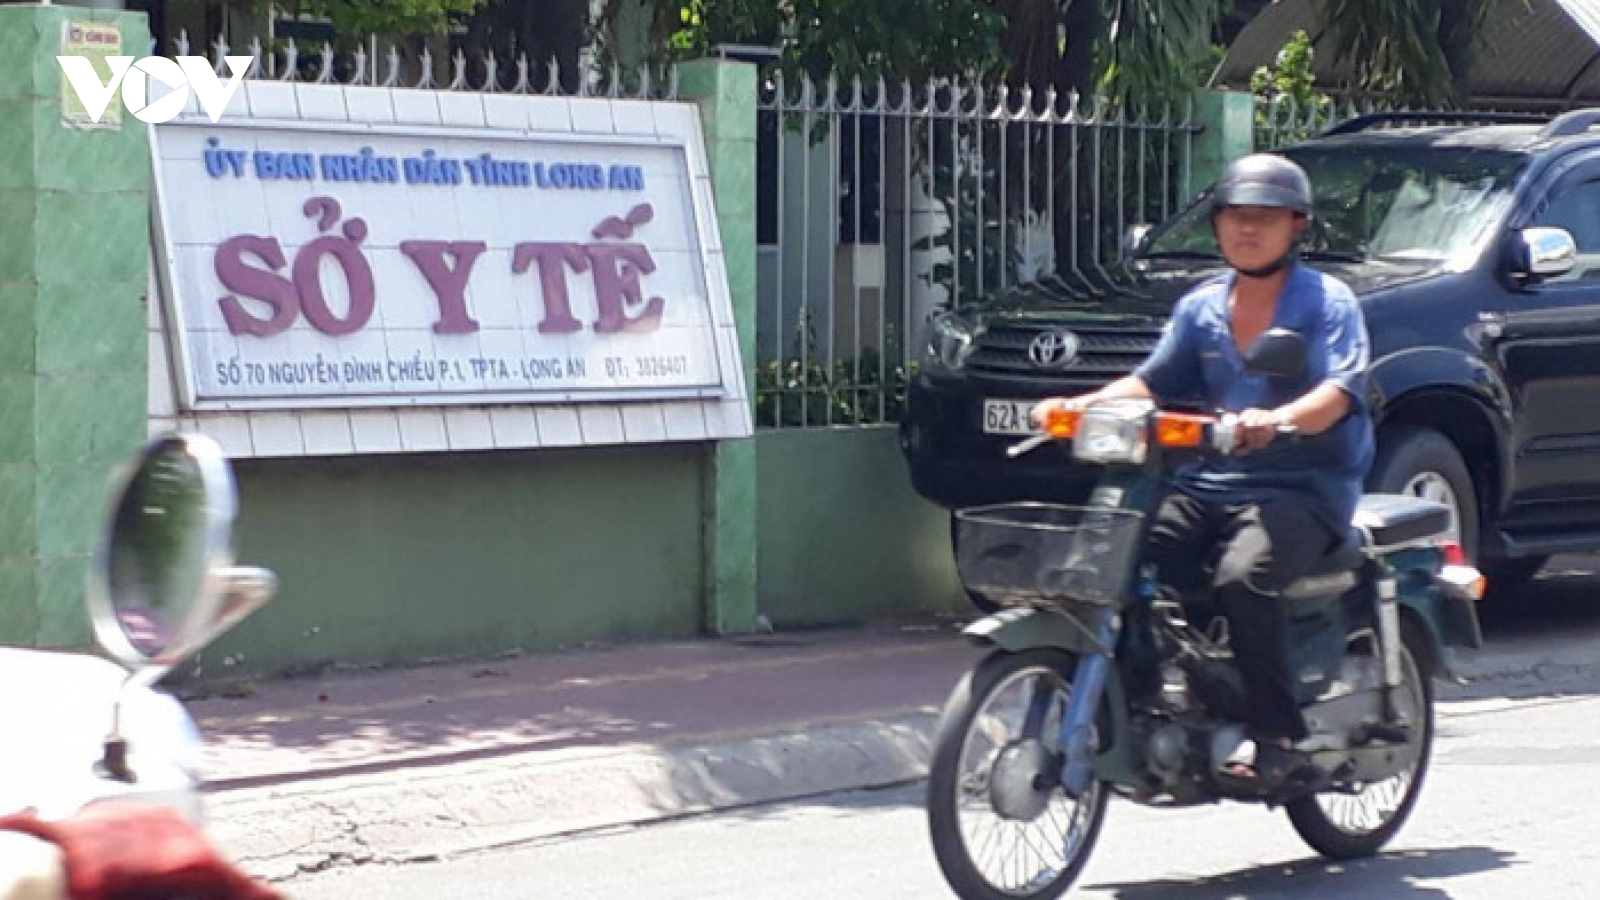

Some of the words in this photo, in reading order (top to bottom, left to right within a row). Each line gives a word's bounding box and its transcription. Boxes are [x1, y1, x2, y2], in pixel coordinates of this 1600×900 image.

[204, 137, 246, 178] ỦY
[253, 151, 315, 180] BAN
[320, 147, 398, 183] NHÂN
[403, 149, 461, 185] DÂN
[464, 153, 530, 187] TỈNH
[534, 163, 605, 190] LONG
[609, 166, 645, 190] AN
[214, 196, 375, 338] SỞ
[400, 240, 487, 335] Y
[512, 203, 666, 334] TẾ
[216, 355, 242, 386] SỐ
[245, 363, 265, 384] 70
[269, 353, 340, 384] NGUYỄN
[344, 356, 384, 384] ĐÌNH
[387, 350, 434, 382] CHIỂU
[469, 358, 510, 379] TPTA
[521, 359, 563, 379] LONG
[566, 357, 586, 378] AN
[635, 355, 687, 376] 3826407
